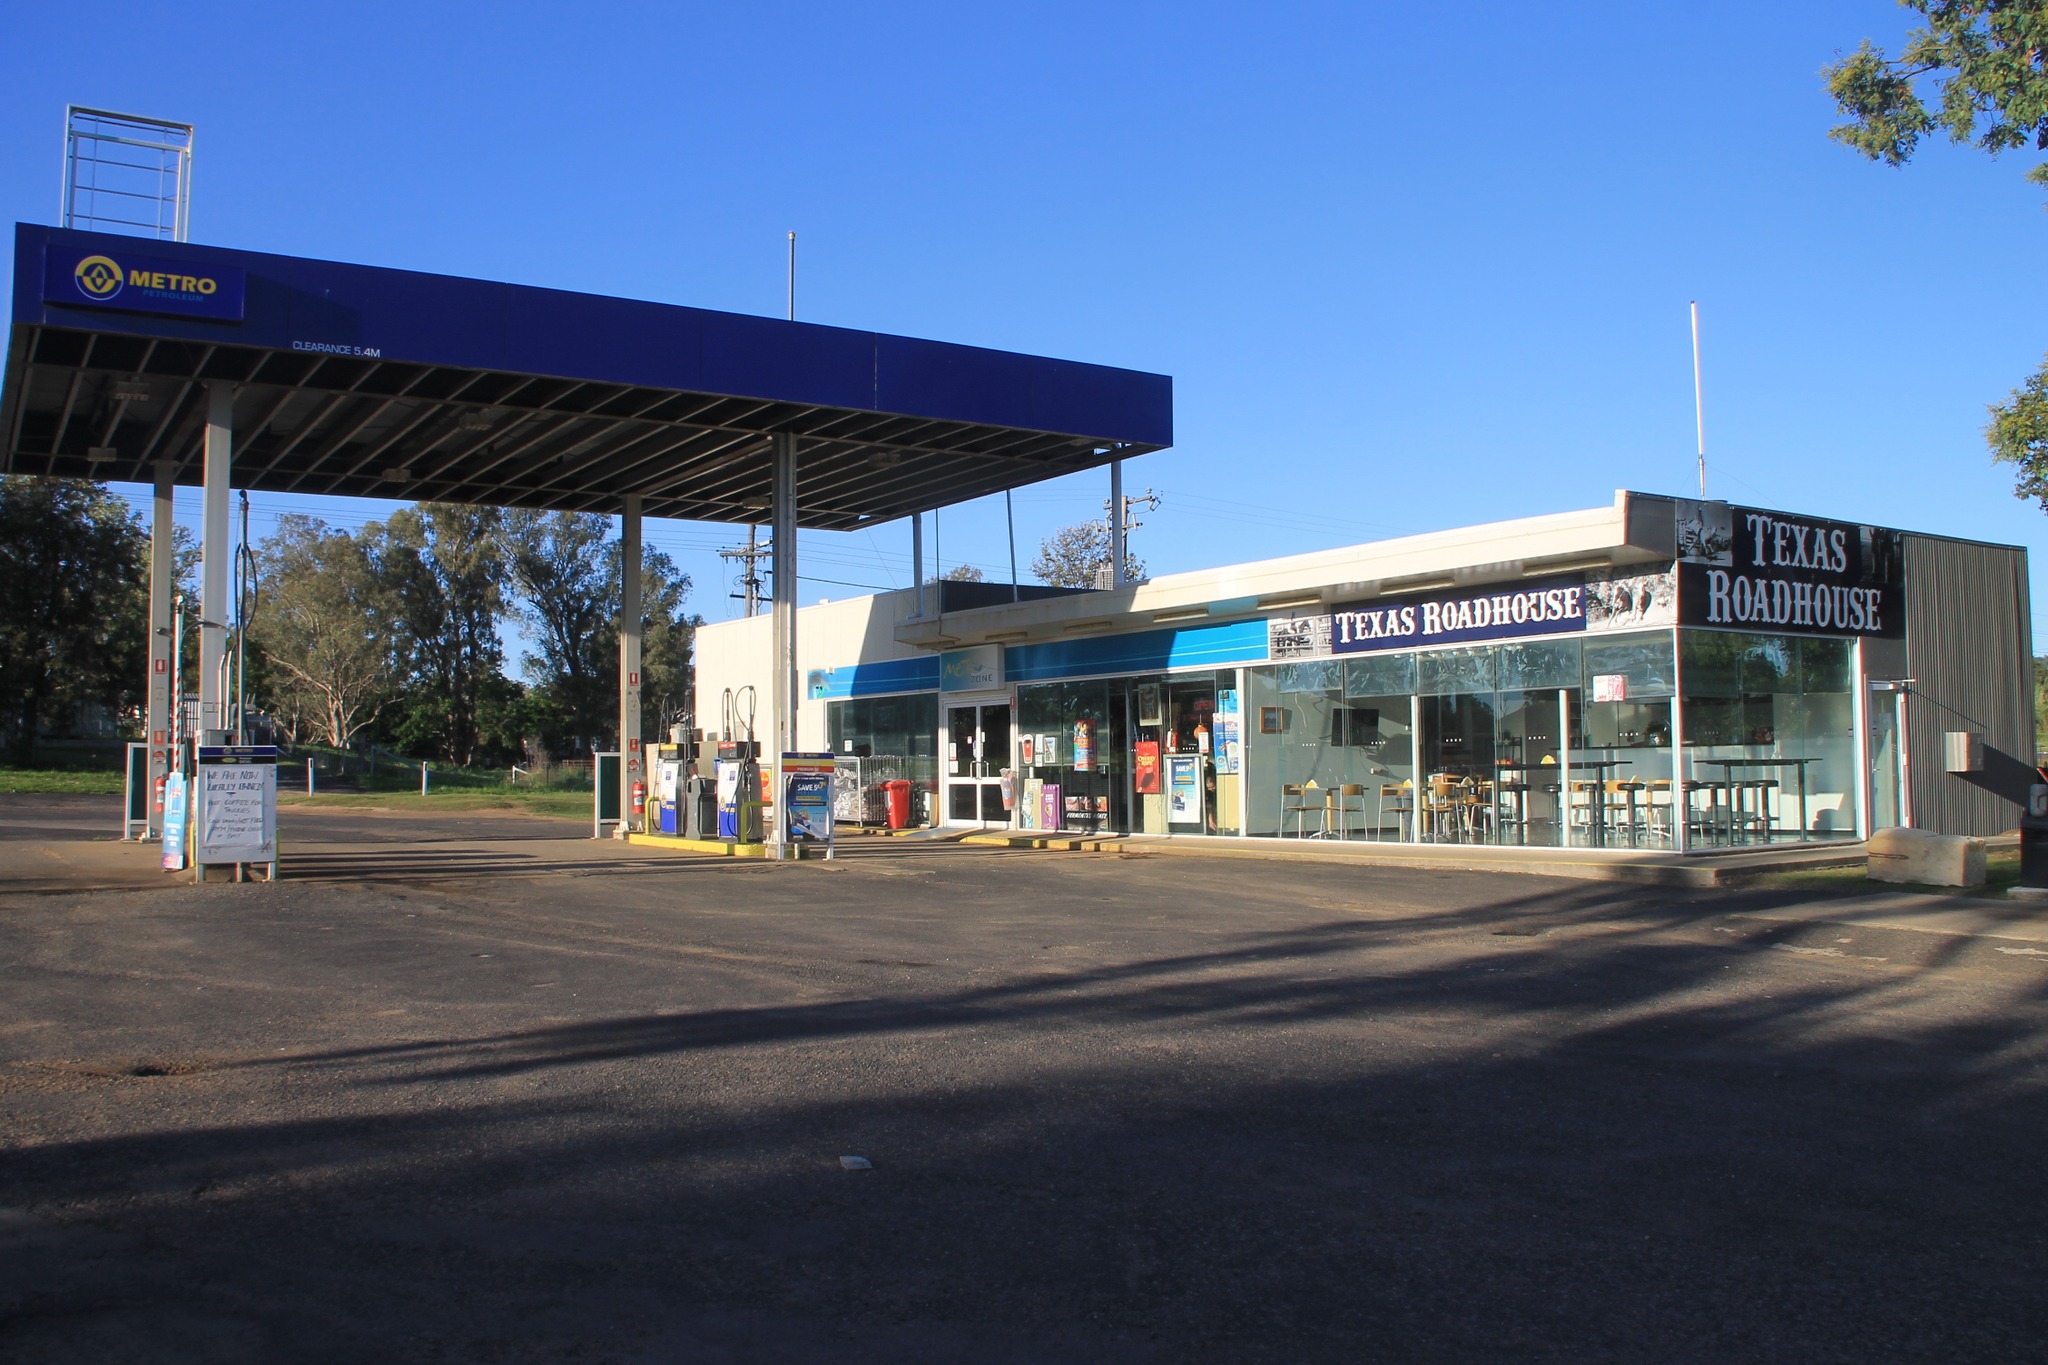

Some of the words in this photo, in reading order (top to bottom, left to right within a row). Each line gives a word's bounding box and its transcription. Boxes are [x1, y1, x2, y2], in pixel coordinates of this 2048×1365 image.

[129, 270, 217, 295] METRO
[143, 289, 204, 303] PETROLEUM
[292, 340, 352, 355] CLEARANCE
[353, 346, 381, 358] 5.4M
[1745, 514, 1848, 573] TEXAS
[1706, 569, 1883, 631] ROADHOUSE
[1335, 606, 1416, 643] TEXAS
[1421, 586, 1582, 635] ROADHOUSE
[970, 674, 993, 683] ZONE
[222, 770, 237, 780] ARE
[240, 770, 260, 780] NOW
[797, 783, 813, 792] SAVE
